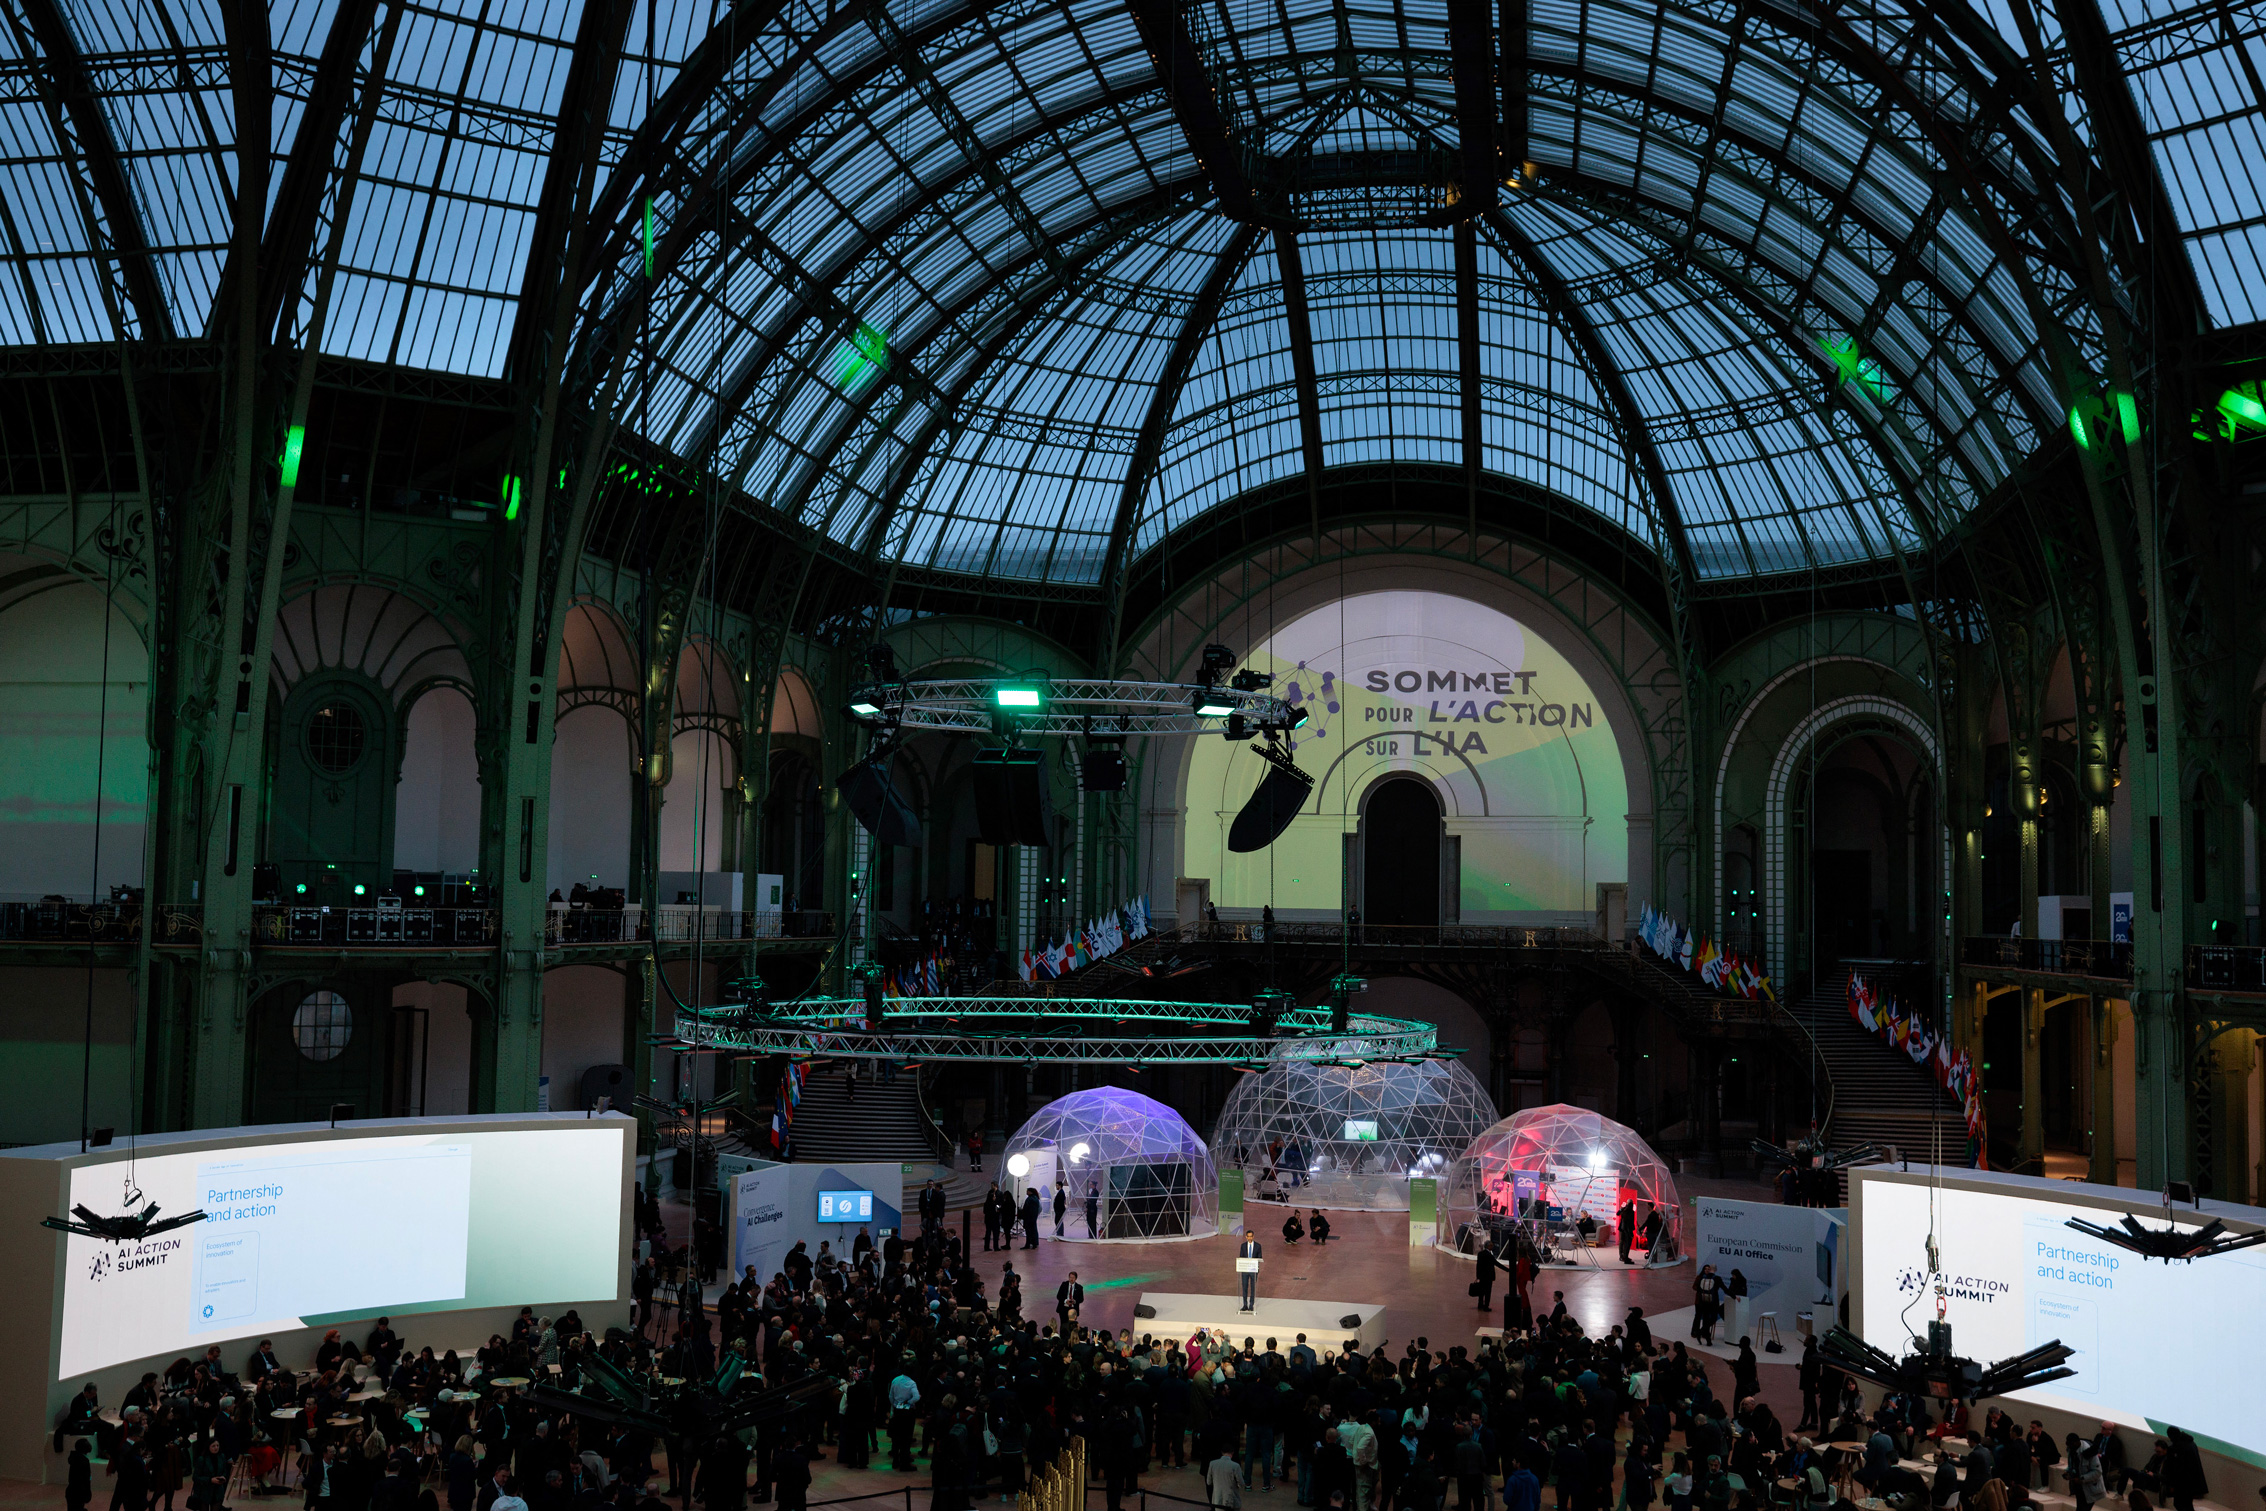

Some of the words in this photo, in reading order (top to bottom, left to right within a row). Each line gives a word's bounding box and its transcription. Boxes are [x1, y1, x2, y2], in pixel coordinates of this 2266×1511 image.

[1365, 669, 1537, 695] SOMMET
[1365, 706, 1413, 723] POUR
[1428, 700, 1593, 729] L'ACTION
[1366, 740, 1399, 756] SUR
[1413, 730, 1489, 757] L'IA
[208, 1183, 283, 1204] Partnership
[207, 1206, 231, 1223] and
[235, 1203, 276, 1219] action
[744, 1203, 775, 1218] Convergence
[747, 1217, 754, 1227] AI
[754, 1211, 784, 1225] Challenges
[118, 1248, 130, 1259] AI
[135, 1239, 181, 1256] ACTION
[206, 1241, 236, 1251] Ecosystem
[236, 1238, 243, 1246] of
[1707, 1233, 1748, 1247] European
[1750, 1239, 1803, 1254] Commission
[1719, 1246, 1731, 1255] EU
[1733, 1248, 1743, 1257] AI
[1745, 1250, 1774, 1261] Office
[118, 1254, 168, 1272] SUMMIT
[206, 1250, 234, 1259] innovation
[2037, 1242, 2120, 1273] Partnership
[1934, 1273, 1949, 1284] AI
[1954, 1275, 2010, 1293] ACTION
[2037, 1265, 2064, 1281] and
[2068, 1271, 2113, 1289] action
[2039, 1298, 2072, 1311] Ecosystem
[2073, 1305, 2080, 1313] of
[2039, 1308, 2071, 1319] innovation
